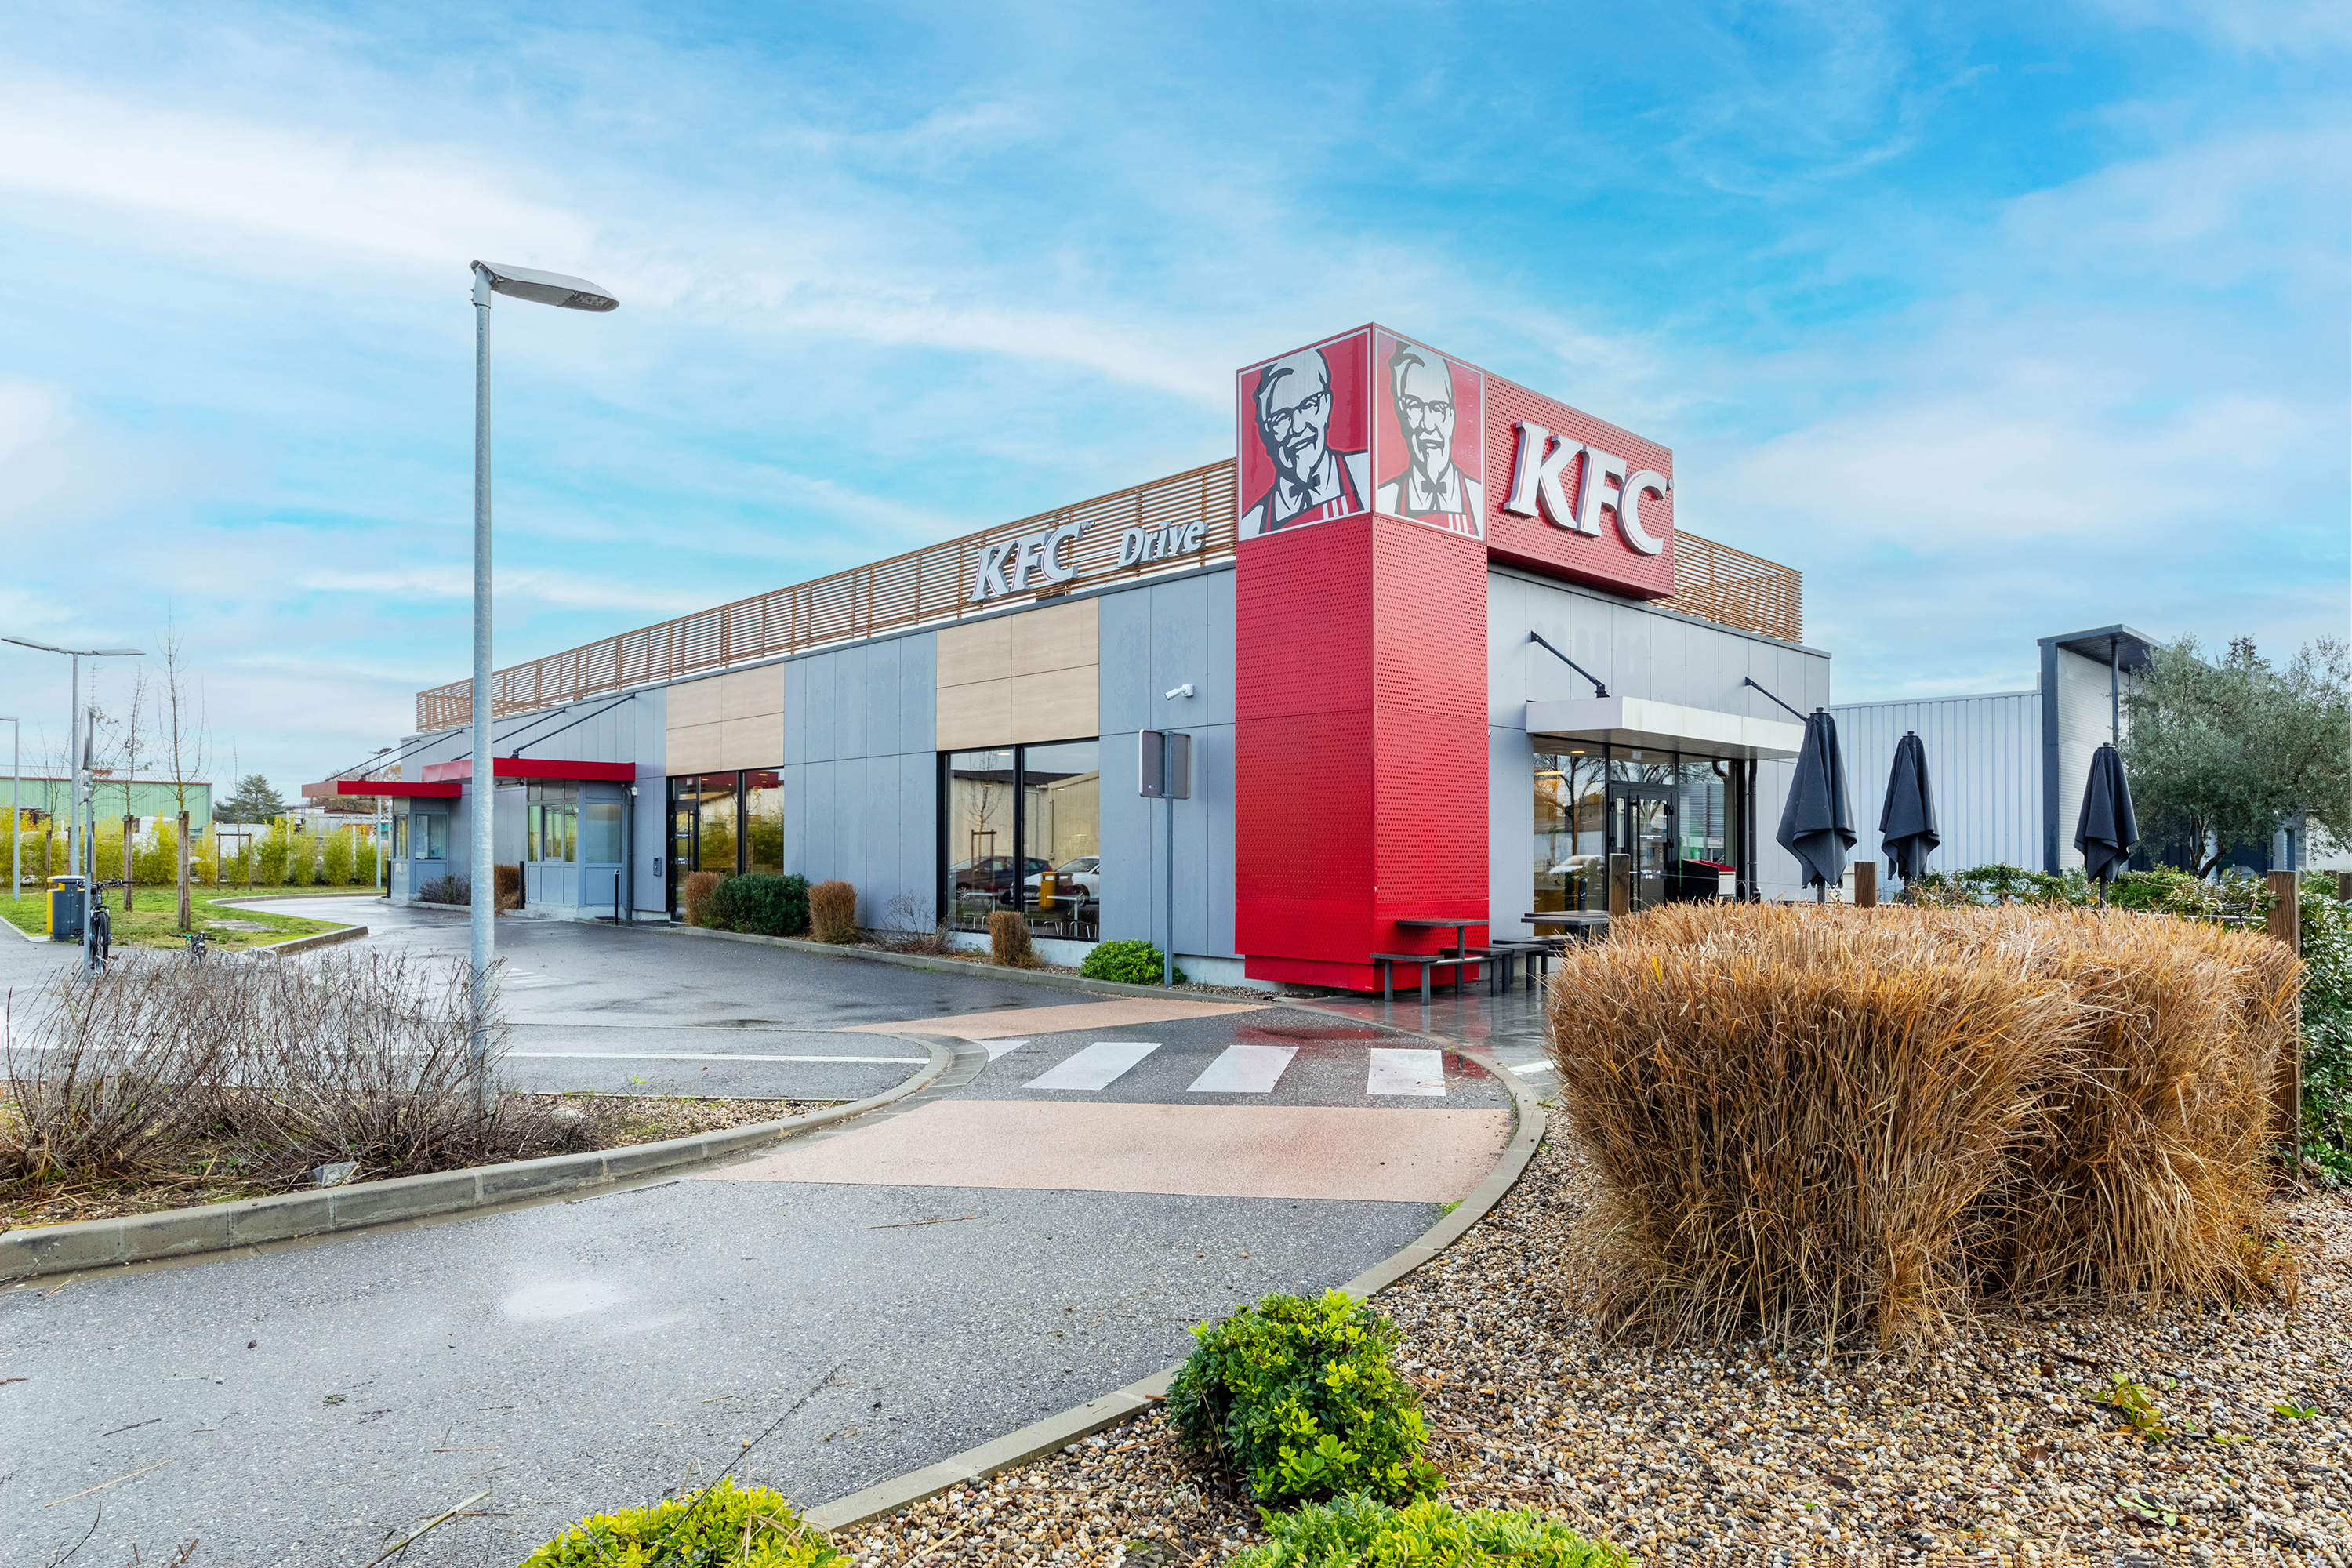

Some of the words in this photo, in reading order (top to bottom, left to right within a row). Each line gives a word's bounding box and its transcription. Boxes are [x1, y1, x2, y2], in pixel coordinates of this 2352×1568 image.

[1503, 420, 1669, 556] KFC
[967, 523, 1080, 602] KFC
[1116, 520, 1208, 568] Drive
